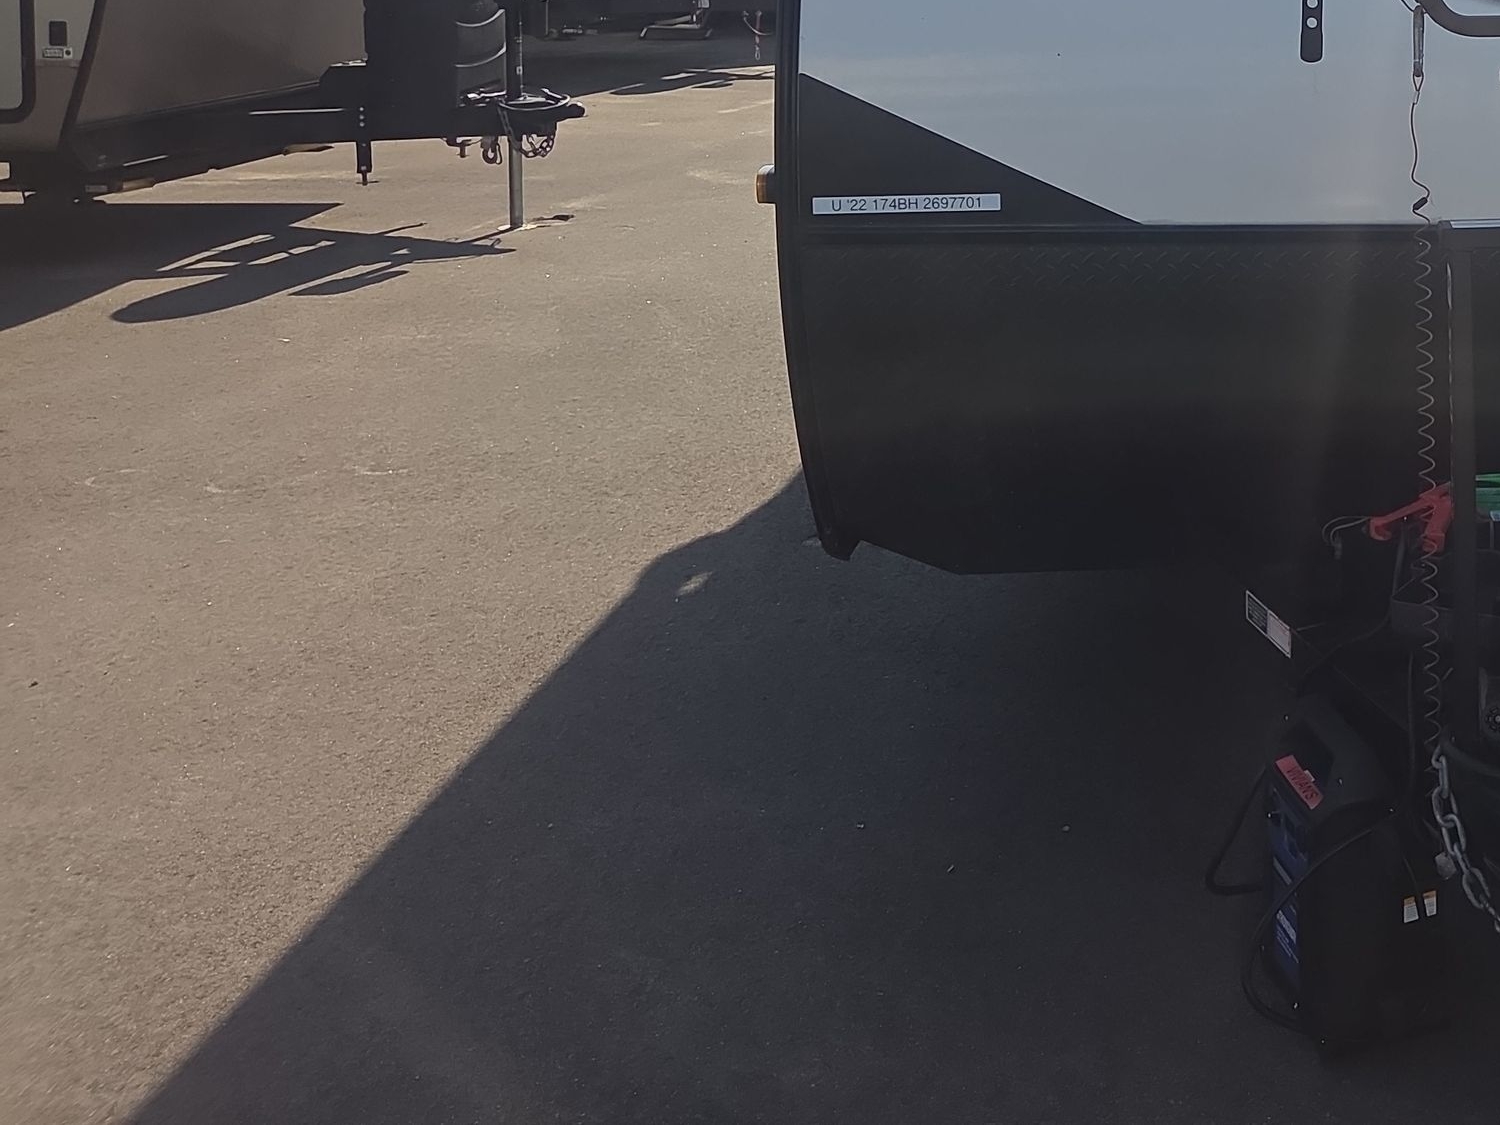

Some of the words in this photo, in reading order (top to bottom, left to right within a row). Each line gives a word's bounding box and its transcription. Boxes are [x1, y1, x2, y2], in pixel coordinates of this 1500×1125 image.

[831, 199, 842, 212] U
[846, 198, 867, 211] '22
[873, 197, 919, 211] 174BH
[923, 196, 983, 210] 2697701
